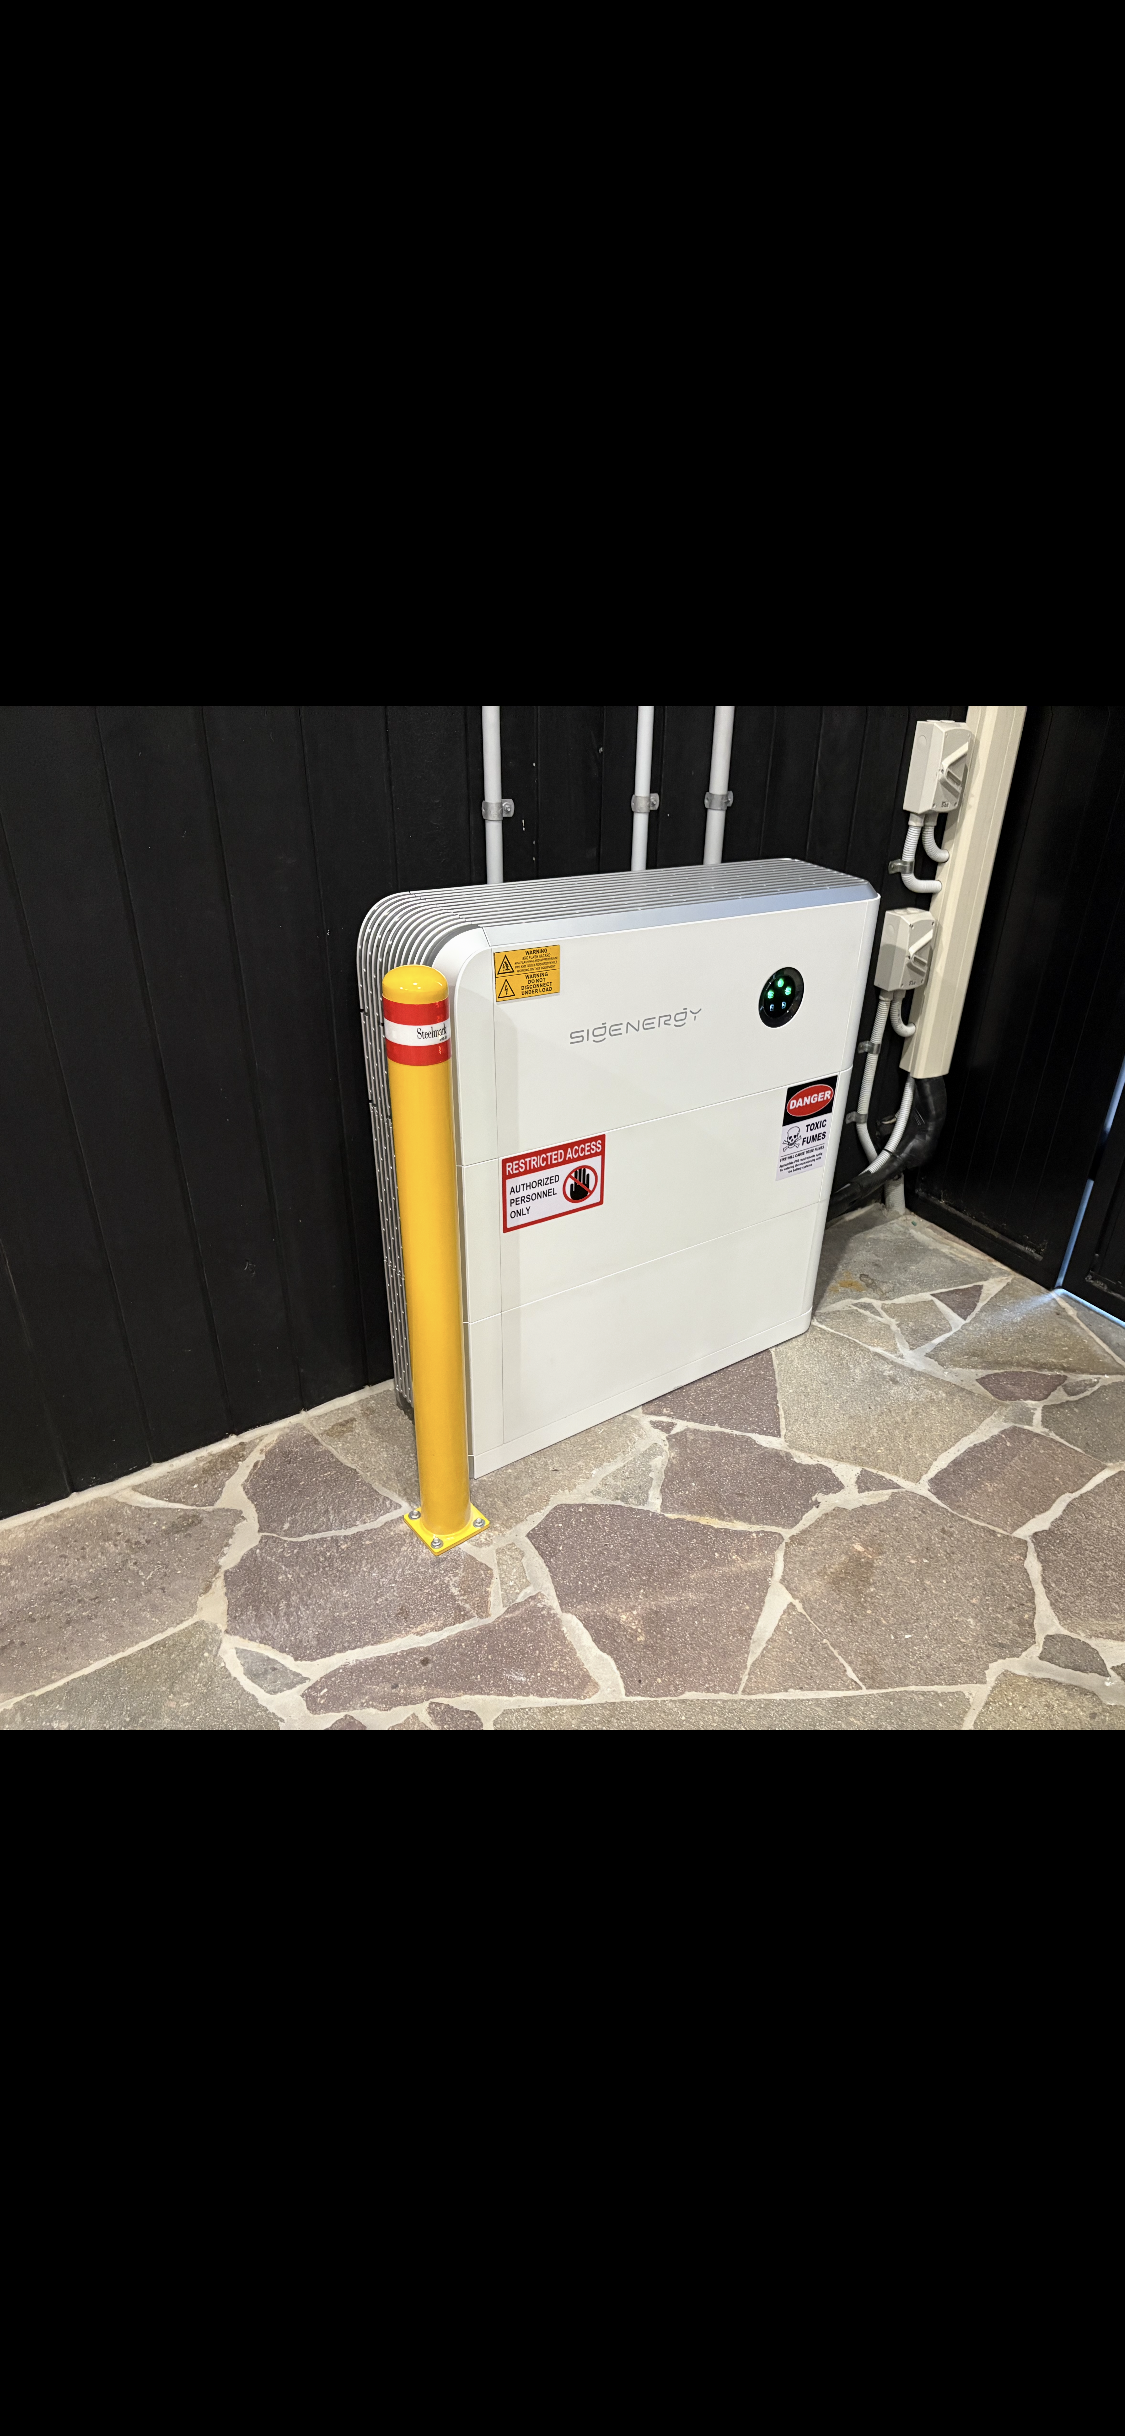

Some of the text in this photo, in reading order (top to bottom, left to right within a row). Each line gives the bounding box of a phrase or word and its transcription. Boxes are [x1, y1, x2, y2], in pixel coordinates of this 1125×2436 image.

[525, 972, 549, 980] WARNING
[521, 981, 553, 991] DISCONNECT
[521, 988, 539, 996] UNDER
[569, 1007, 702, 1045] SIGENERGY
[789, 1090, 832, 1110] DANGER
[805, 1119, 827, 1133] TOXIC
[802, 1131, 827, 1146] FUMES
[506, 1139, 602, 1176] RESTRICTED ACCESS
[509, 1174, 560, 1196] AUTHORIZED
[509, 1187, 558, 1208] PERSONNEL
[509, 1206, 531, 1219] ONLY
